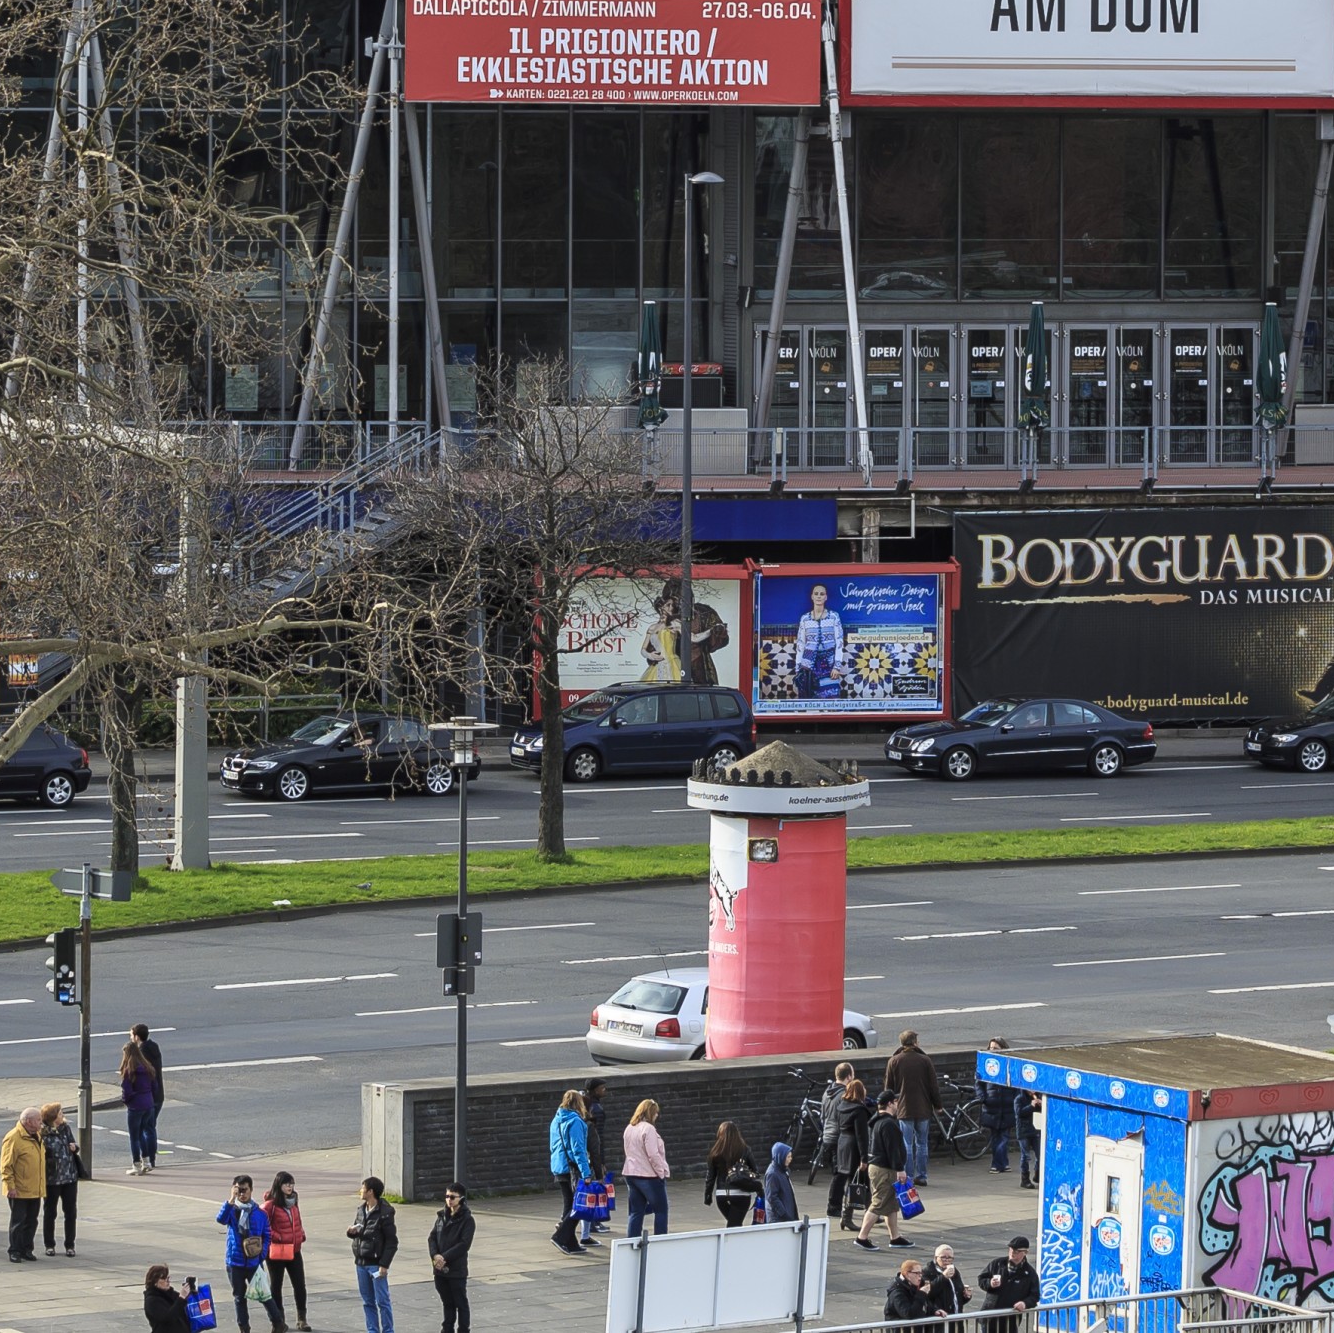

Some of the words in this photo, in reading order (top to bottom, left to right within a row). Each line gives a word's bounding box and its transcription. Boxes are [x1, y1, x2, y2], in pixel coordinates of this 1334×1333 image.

[413, 0, 528, 17] DALLAPICCOLA
[542, 0, 656, 18] ZIMMERMANN
[702, 2, 816, 19] 27.03.-06.04.
[509, 28, 533, 54] IL
[540, 28, 700, 55] PRIGIONIERO
[458, 57, 672, 85] EKKLESIASTISCHE
[679, 58, 768, 86] AKTION
[506, 89, 545, 99] KARTEN:
[547, 89, 589, 100] 0221.221
[593, 90, 604, 100] 28
[607, 90, 625, 100] 400
[633, 90, 738, 101] WWW.OPERKOELN.COM
[1199, 590, 1238, 605] DAS
[843, 599, 866, 611] mit
[866, 599, 901, 615] grüner
[901, 598, 926, 615] Seele
[566, 631, 626, 654] BIEST
[851, 634, 929, 642] www.gudrunsjoeden.de
